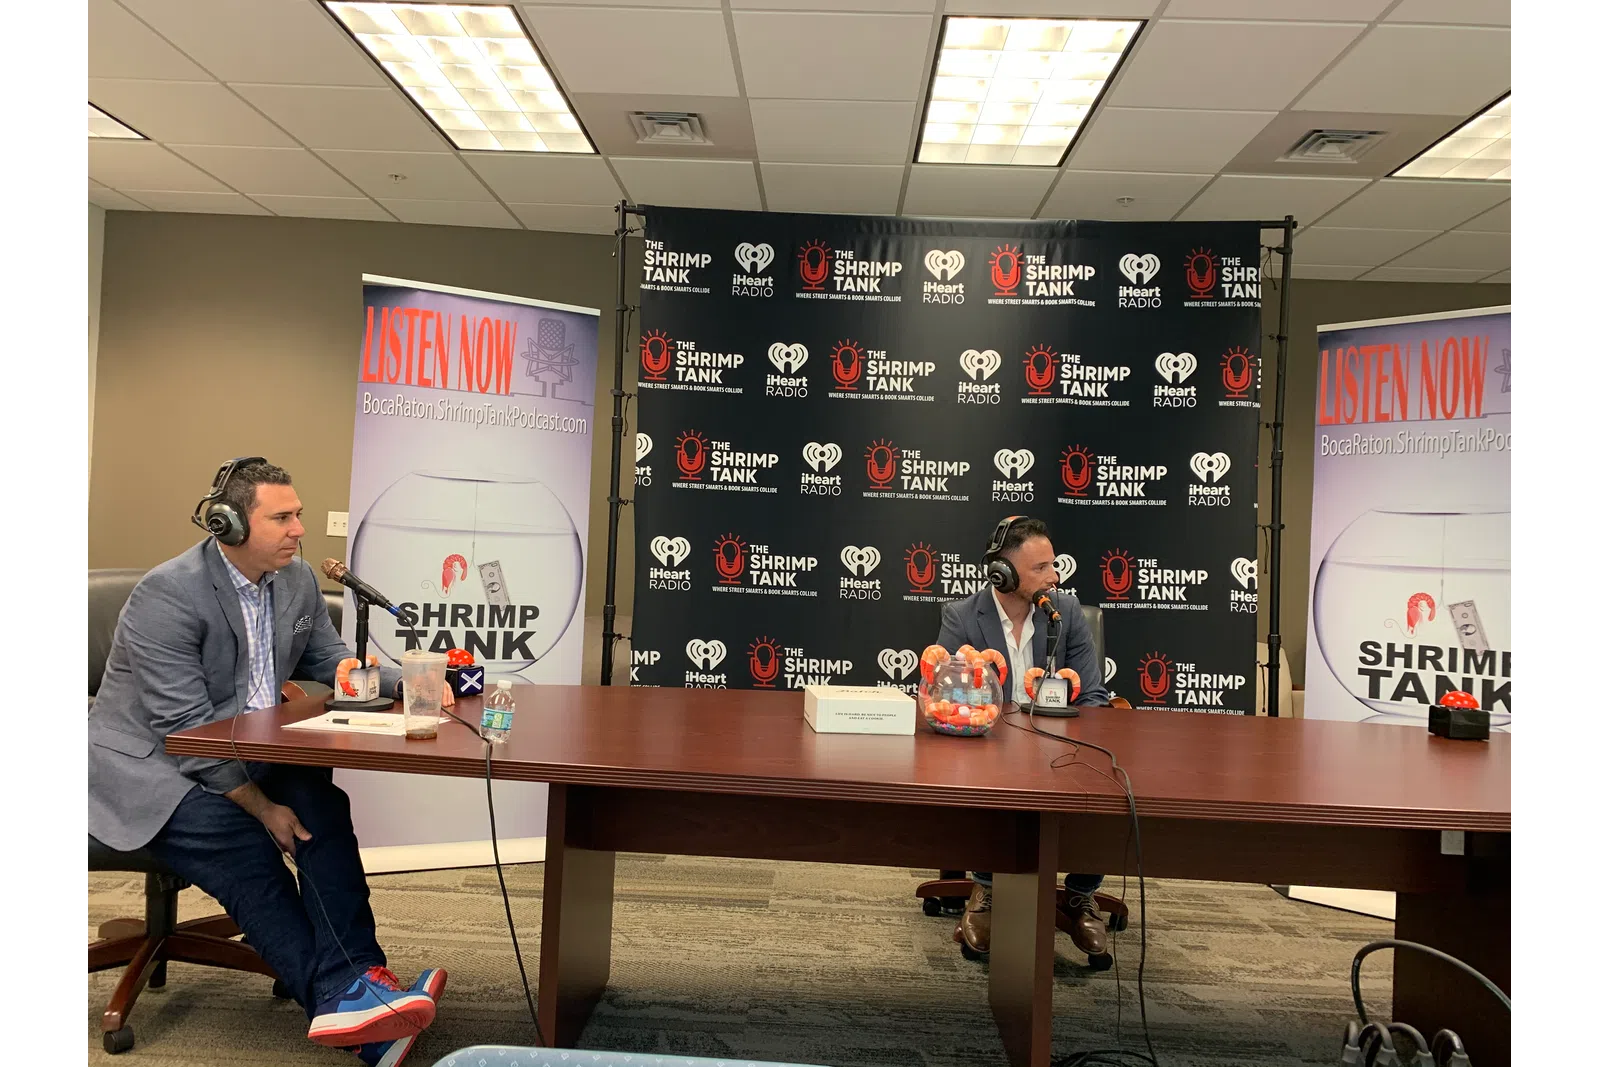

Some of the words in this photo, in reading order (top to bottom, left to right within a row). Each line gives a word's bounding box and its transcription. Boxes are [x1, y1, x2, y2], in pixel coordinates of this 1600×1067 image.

[645, 240, 663, 250] THE
[645, 250, 711, 268] SHRIMP
[835, 250, 853, 259] THE
[1026, 256, 1045, 264] THE
[1221, 257, 1240, 265] THE
[834, 260, 902, 276] SHRIMP
[1026, 265, 1095, 280] SHRIMP
[643, 266, 690, 283] TANK
[733, 274, 773, 286] iHeart
[833, 277, 881, 292] TANK
[924, 281, 964, 293] iHeart
[1026, 282, 1074, 296] TANK
[732, 286, 773, 297] RADIO
[1119, 286, 1161, 297] iHeart
[923, 294, 964, 304] RADIO
[1119, 297, 1162, 308] RADIO
[362, 306, 451, 389] LISTEN
[458, 314, 518, 396] NOW
[676, 341, 695, 350] THE
[676, 351, 744, 368] SHRIMP
[867, 350, 886, 359] THE
[1061, 354, 1080, 363] THE
[867, 360, 936, 376] SHRIMP
[1061, 364, 1130, 381] SHRIMP
[675, 367, 722, 383] TANK
[767, 374, 807, 387] iHeart
[1319, 342, 1411, 425] LISTEN
[1419, 336, 1490, 420] NOW
[866, 377, 914, 392] TANK
[959, 381, 1000, 393] iHeart
[1060, 381, 1108, 397] TANK
[1154, 385, 1196, 396] iHeart
[766, 386, 808, 398] RADIO
[958, 394, 1000, 404] RADIO
[1154, 397, 1197, 407] RADIO
[363, 392, 588, 434] BocaRaton.ShrimpTankPodcast.com
[711, 441, 730, 450] THE
[711, 451, 779, 468] SHRIMP
[902, 450, 921, 459] THE
[1097, 456, 1117, 464] THE
[901, 459, 970, 476] SHRIMP
[1097, 466, 1167, 480] SHRIMP
[710, 467, 757, 483] TANK
[802, 473, 841, 485] iHeart
[901, 476, 948, 491] TANK
[993, 480, 1034, 491] iHeart
[1096, 482, 1145, 496] TANK
[1189, 484, 1230, 495] iHeart
[801, 485, 841, 496] RADIO
[992, 492, 1034, 502] RADIO
[1189, 496, 1231, 506] RADIO
[750, 545, 769, 553] THE
[750, 554, 818, 571] SHRIMP
[941, 553, 960, 562] THE
[1138, 559, 1157, 567] THE
[650, 567, 690, 580] iHeart
[749, 571, 797, 587] TANK
[1138, 569, 1208, 584] SHRIMP
[650, 579, 691, 591] RADIO
[840, 577, 881, 589] iHeart
[941, 580, 989, 594] TANK
[840, 589, 881, 600] RADIO
[1137, 586, 1187, 601] TANK
[1231, 590, 1257, 602] iHea
[1231, 602, 1257, 613] RAD
[397, 602, 540, 629] SHRIMP
[395, 629, 538, 660] TANK
[784, 648, 803, 657] THE
[784, 657, 853, 675] SHRIMP
[1176, 663, 1195, 672] THE
[685, 670, 726, 684] iHeart
[784, 674, 832, 688] TANK
[1176, 673, 1246, 690] SHRIMP
[1175, 690, 1224, 705] TANK
